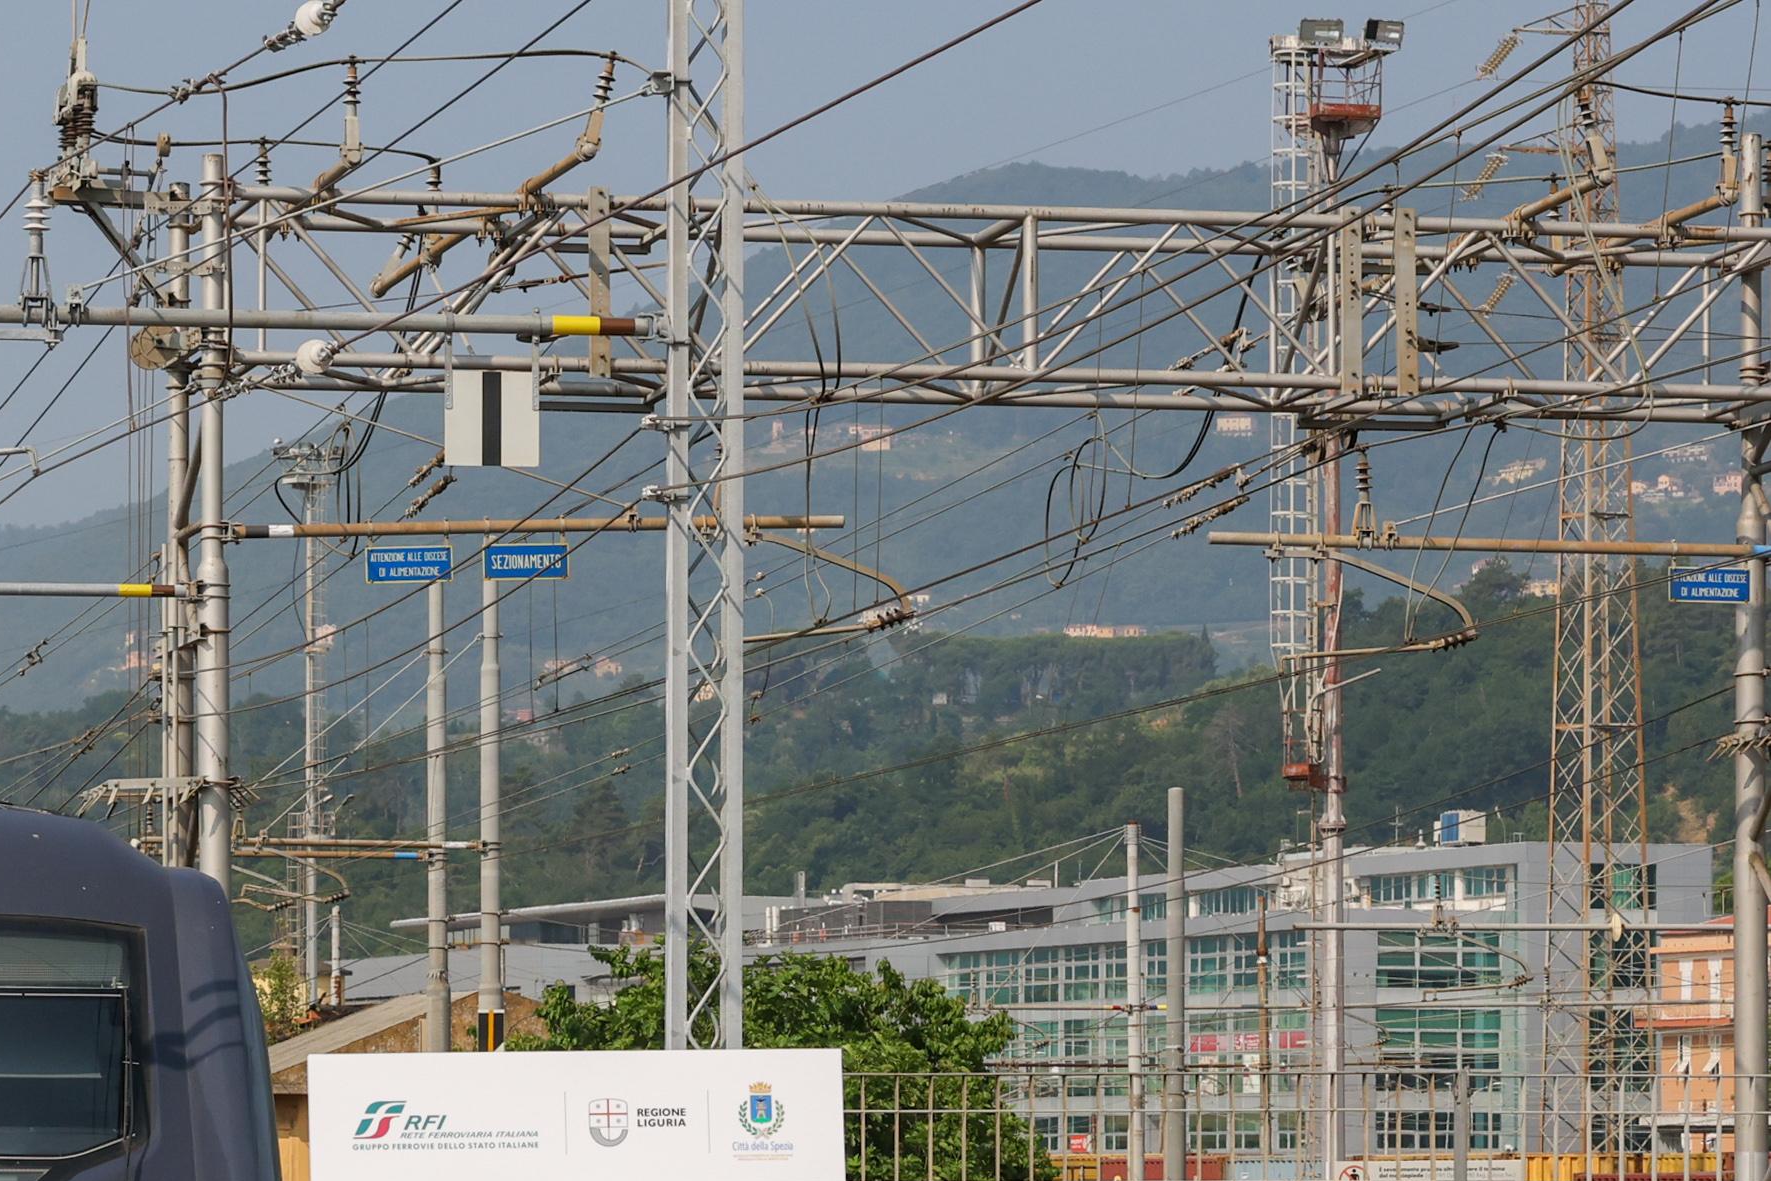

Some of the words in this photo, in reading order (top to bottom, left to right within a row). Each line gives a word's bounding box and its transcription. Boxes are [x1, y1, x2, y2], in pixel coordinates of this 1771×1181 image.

[370, 552, 405, 562] ATTENZIONE
[407, 552, 422, 561] ALLE
[424, 551, 448, 561] DISCESE
[491, 554, 561, 570] SEZIONAMENTO
[378, 567, 386, 577] DI
[389, 566, 440, 577] ALIMENTAZIONE
[637, 1108, 687, 1117] REGIONE
[404, 1115, 447, 1130] RFI
[637, 1118, 687, 1127] LIGURIA
[400, 1131, 425, 1139] RETE
[428, 1131, 493, 1139] FERROVIARIA
[495, 1130, 539, 1138] ITALIANA
[352, 1143, 389, 1151] GRUPPO
[392, 1142, 435, 1150] FERROVIE
[438, 1142, 466, 1150] DELLO
[498, 1141, 539, 1149] ITALIANE
[770, 1140, 794, 1152] Spezia
